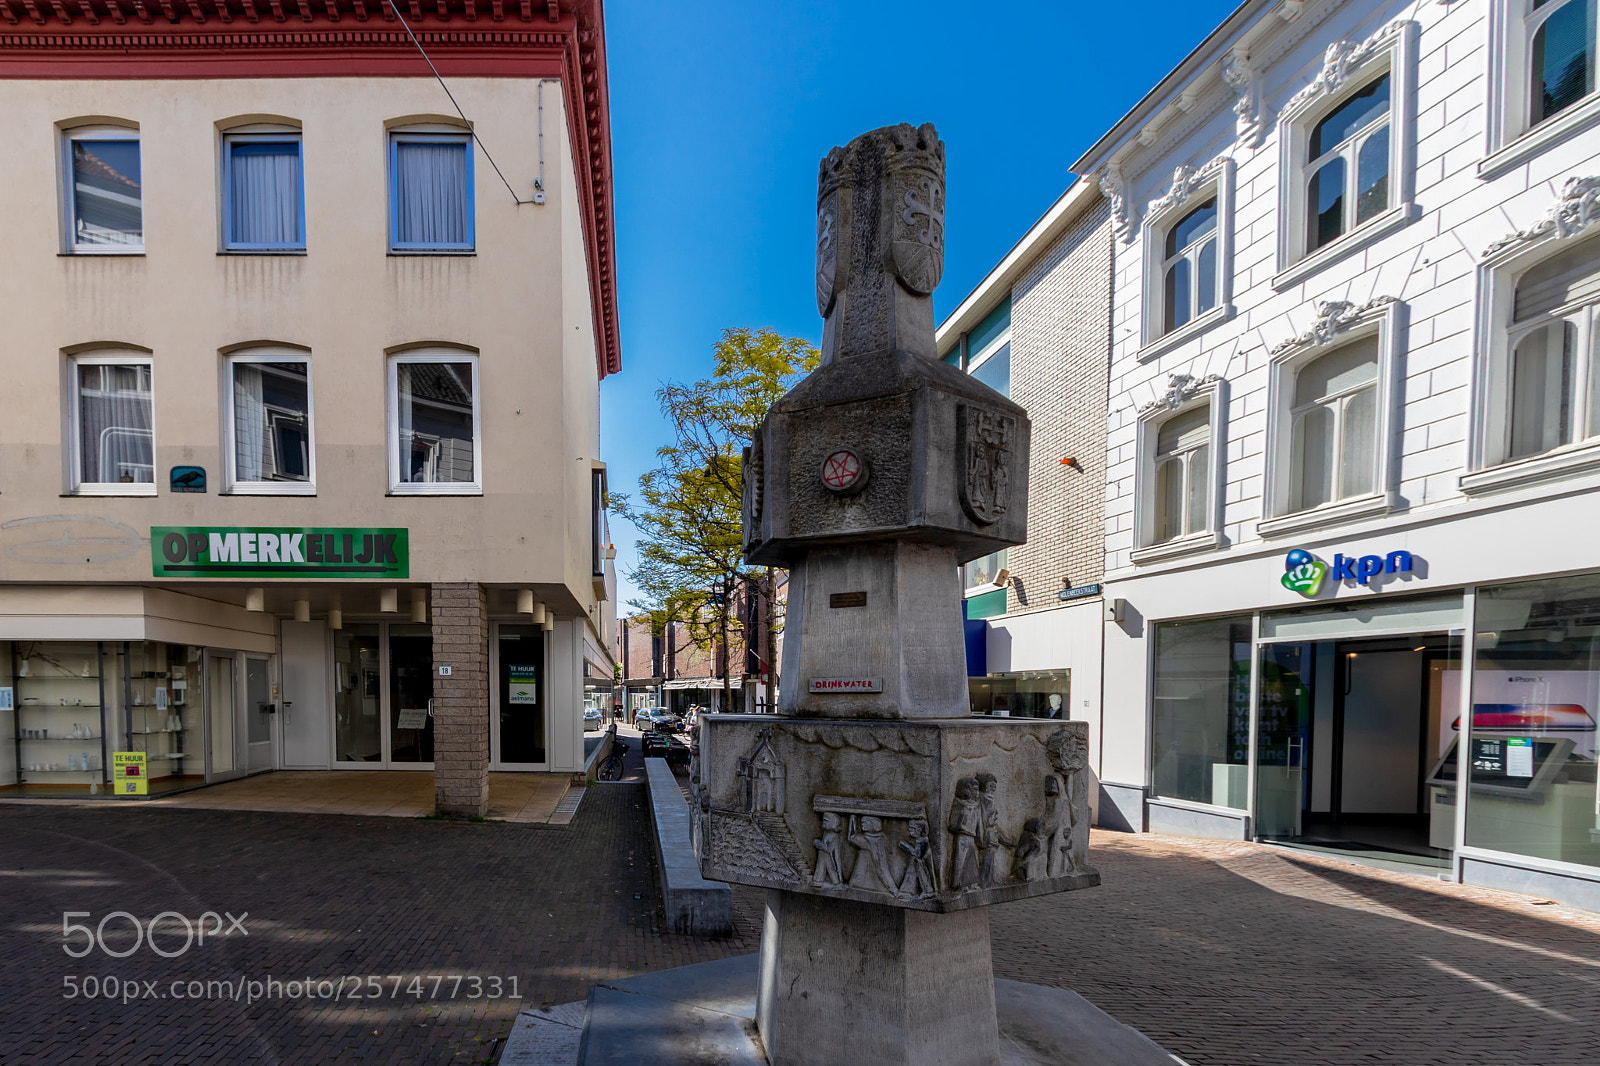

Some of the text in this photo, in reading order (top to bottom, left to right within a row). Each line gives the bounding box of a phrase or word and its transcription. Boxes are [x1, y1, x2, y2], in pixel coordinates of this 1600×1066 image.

[162, 532, 398, 564] OPMERKELIJK
[1333, 550, 1412, 584] kpn
[441, 667, 449, 675] 18
[815, 680, 873, 690] DRINKWATER
[1236, 675, 1265, 688] Ht
[1234, 732, 1271, 746] toh
[1234, 746, 1286, 760] oine
